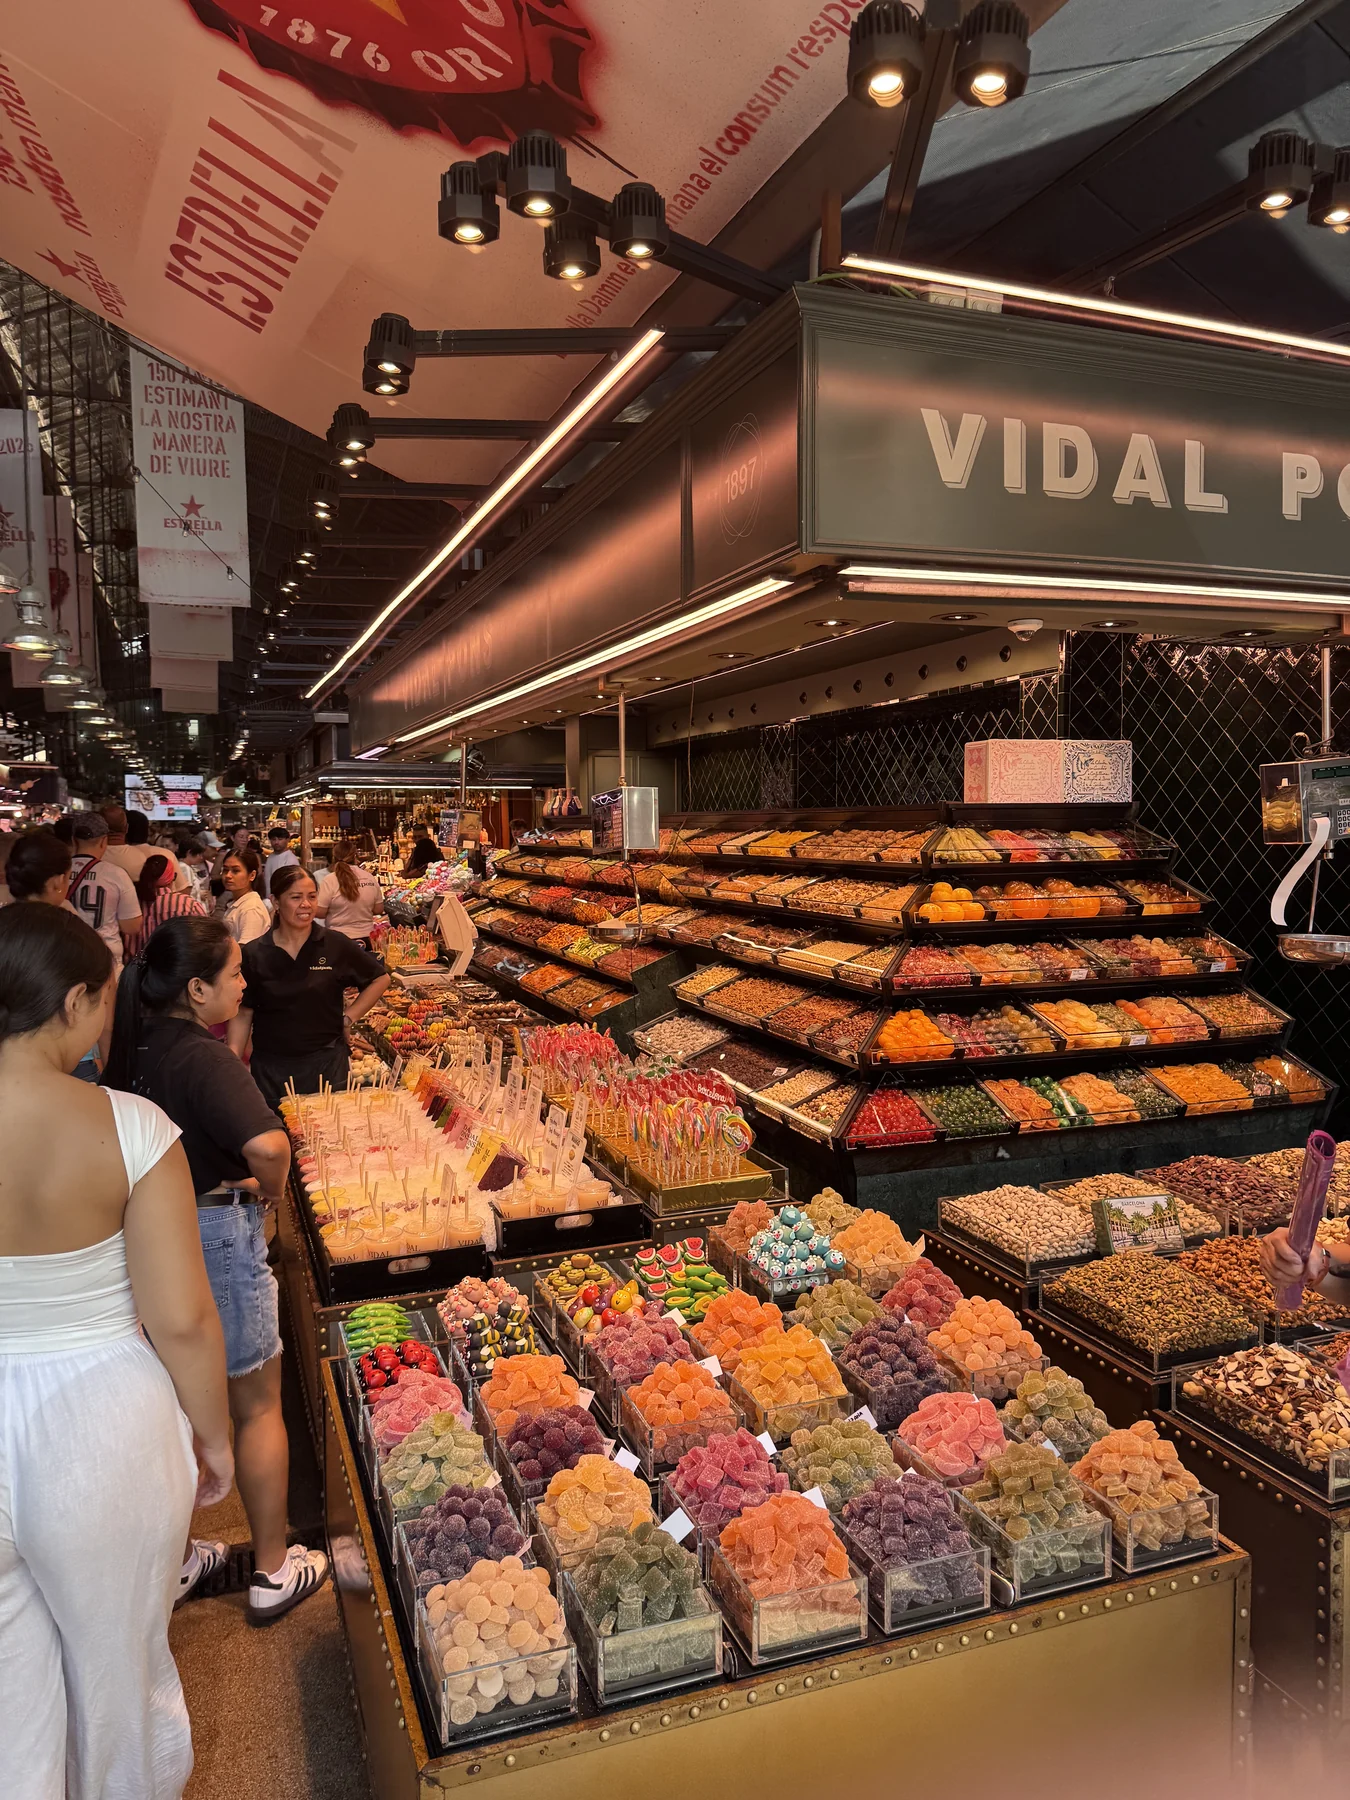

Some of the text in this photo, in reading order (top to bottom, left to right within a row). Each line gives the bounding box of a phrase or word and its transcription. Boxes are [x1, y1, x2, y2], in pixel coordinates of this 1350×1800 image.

[260, 5, 391, 73] 1876
[699, 146, 729, 176] el
[715, 63, 801, 156] consum
[164, 68, 358, 335] ESTRELLA
[73, 250, 124, 319] ESTRELLA
[140, 407, 237, 434] LA NOSTRA
[144, 384, 230, 411] ESTIMANT
[150, 454, 231, 479] DE VIURE
[153, 431, 227, 455] MANERA
[920, 407, 1229, 514] VIDAL
[725, 455, 757, 504] 1897
[163, 518, 223, 532] ESTRELLA
